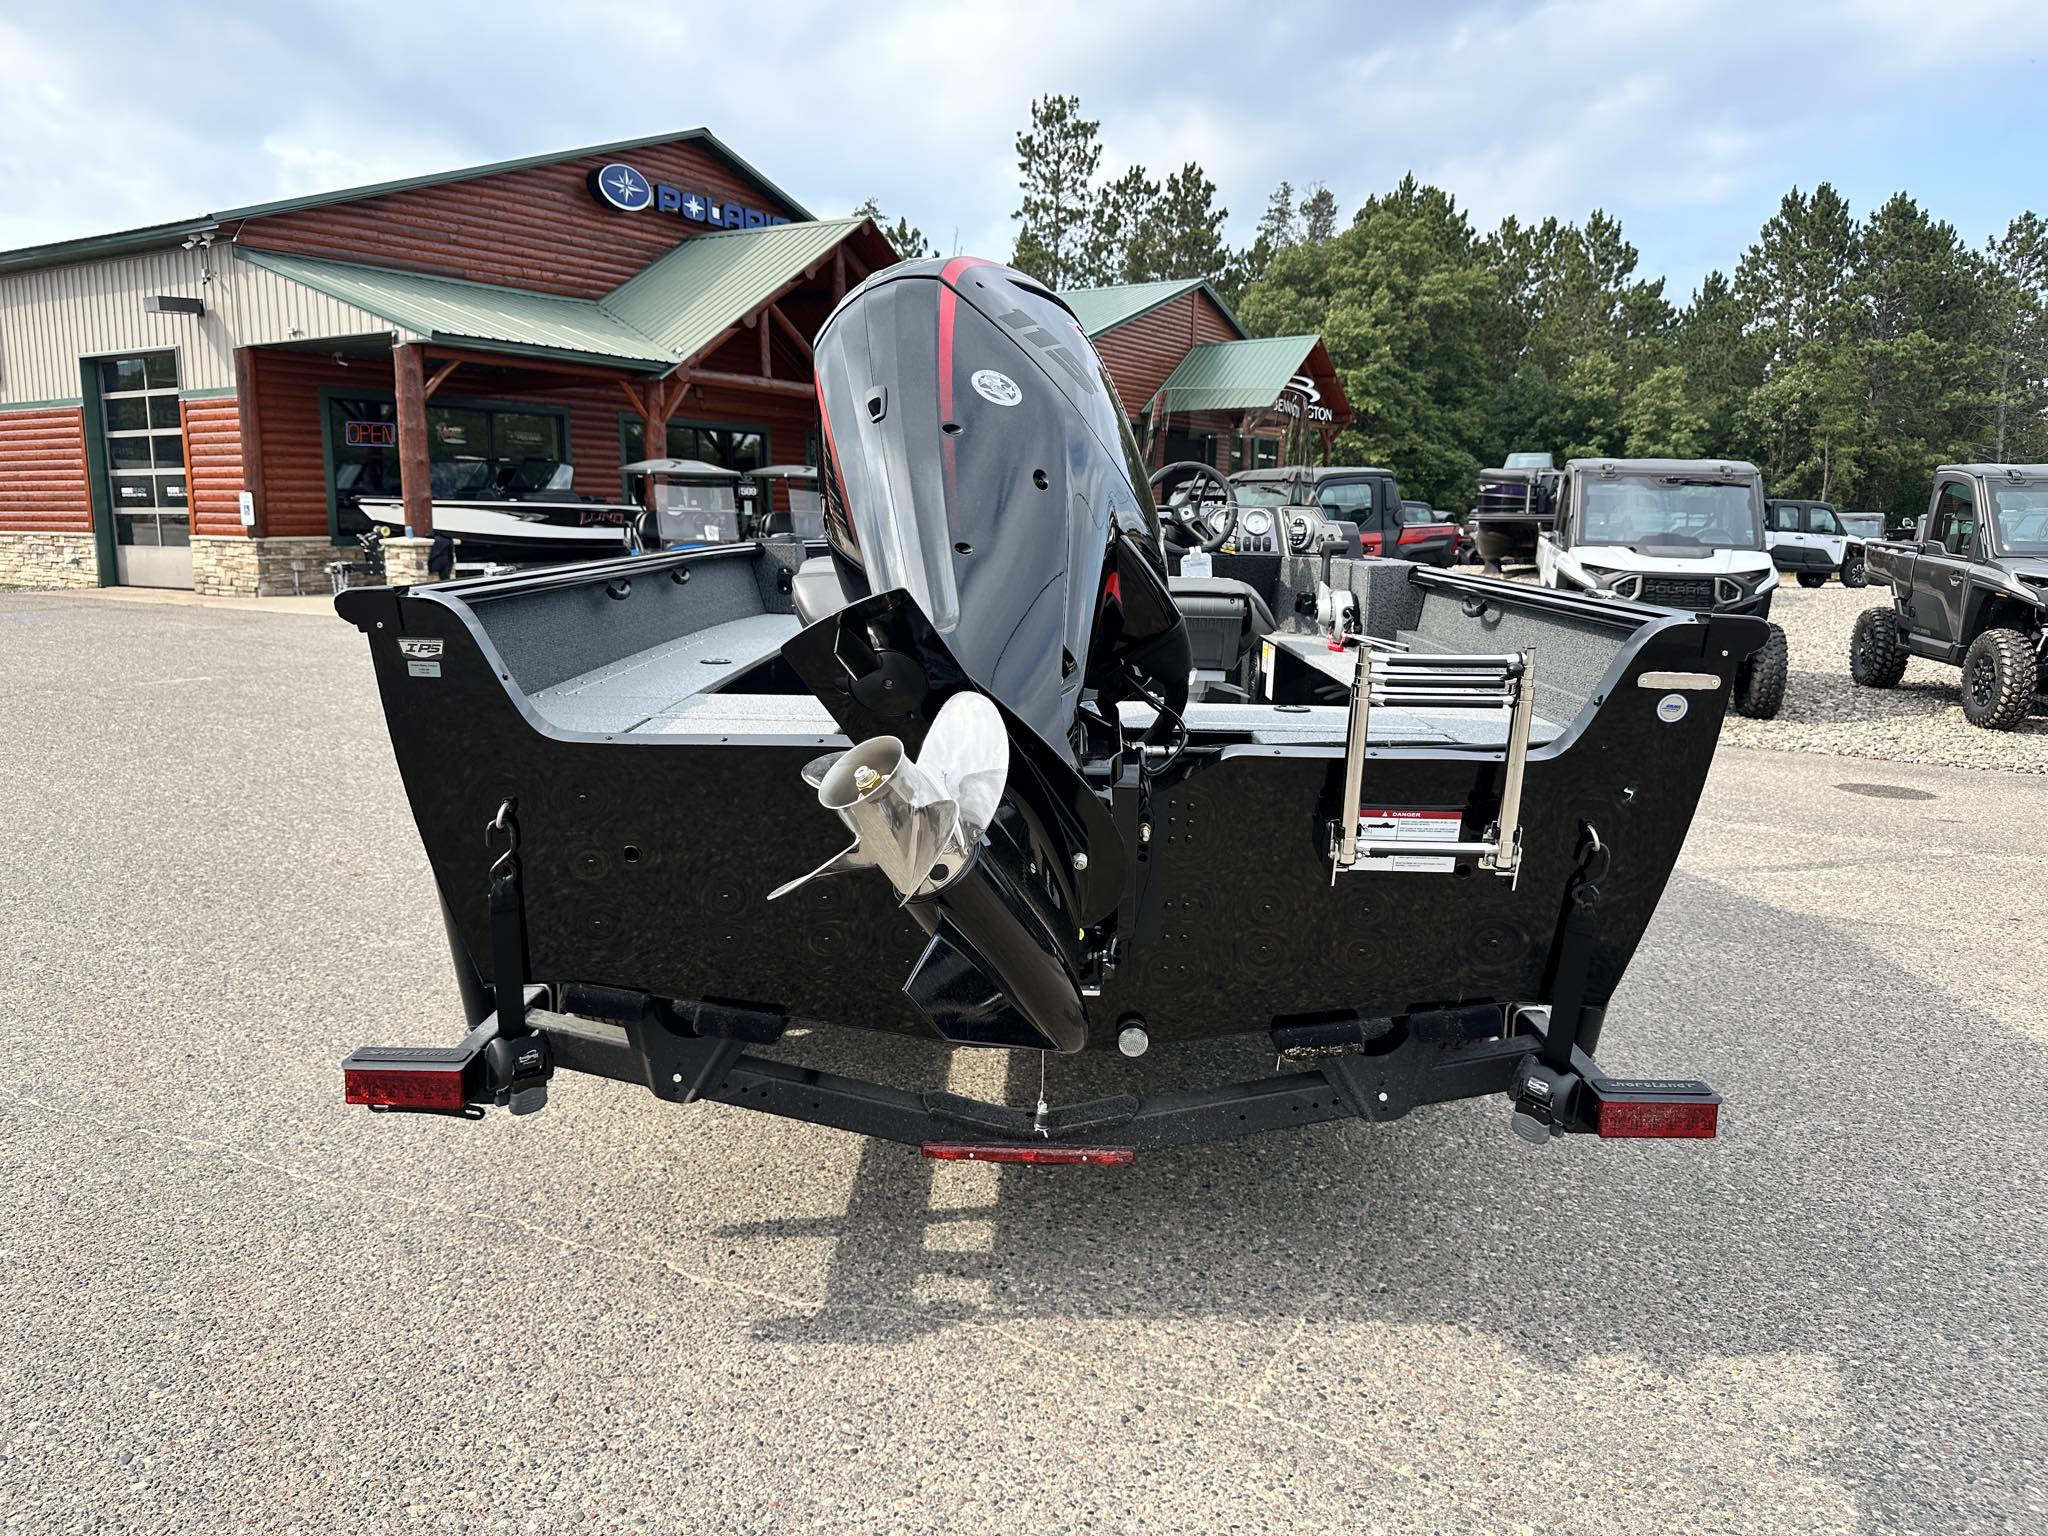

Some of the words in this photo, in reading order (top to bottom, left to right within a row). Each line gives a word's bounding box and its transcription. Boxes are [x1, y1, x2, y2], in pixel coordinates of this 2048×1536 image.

[348, 424, 394, 444] OPEN
[1645, 584, 1711, 595] POLARIS
[405, 643, 441, 653] IPS
